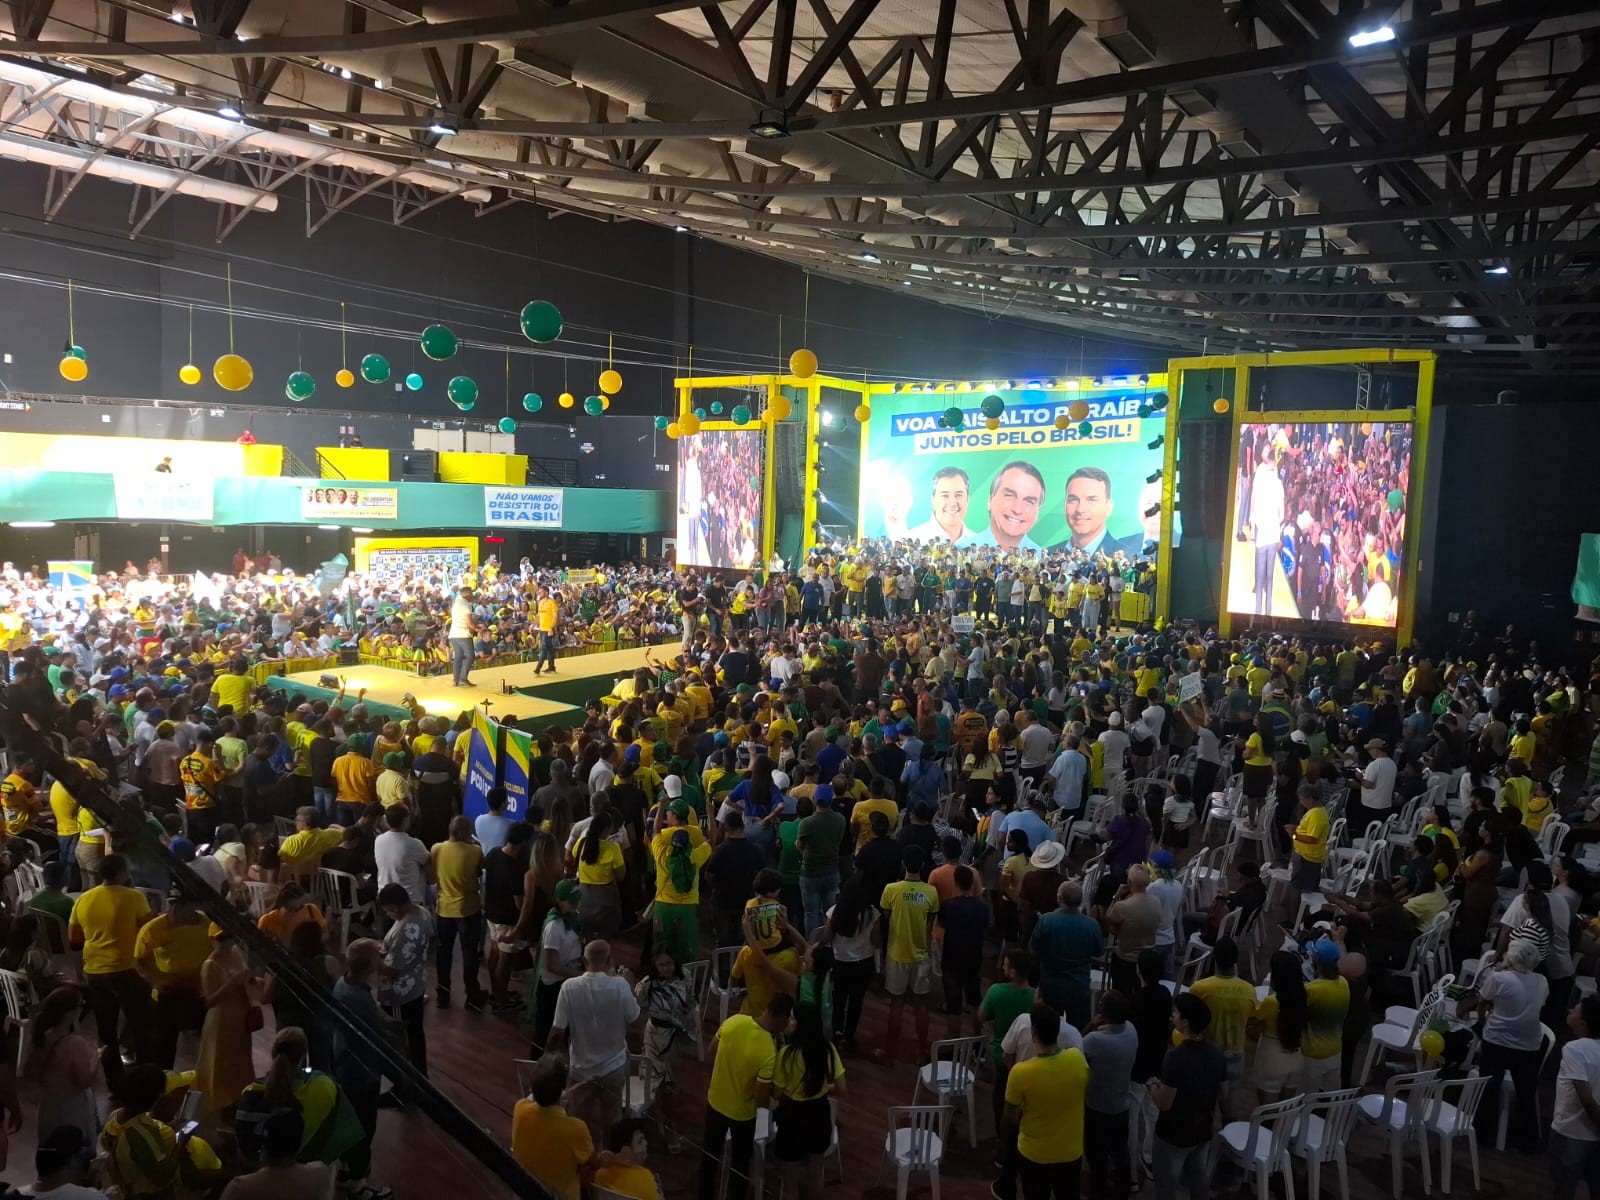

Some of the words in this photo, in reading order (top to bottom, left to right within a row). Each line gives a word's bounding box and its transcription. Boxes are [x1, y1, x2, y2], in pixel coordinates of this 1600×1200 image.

[896, 416, 937, 432] VOA
[940, 411, 988, 429] AIS
[999, 407, 1051, 424] ALTO
[1054, 396, 1166, 420] PRAÍB
[920, 433, 993, 449] JUNTOS
[996, 430, 1046, 446] PELO
[496, 491, 518, 501] NÃO
[521, 494, 553, 502] VAMOS
[489, 501, 541, 510] DESISTIR
[491, 511, 560, 521] BRASIL!
